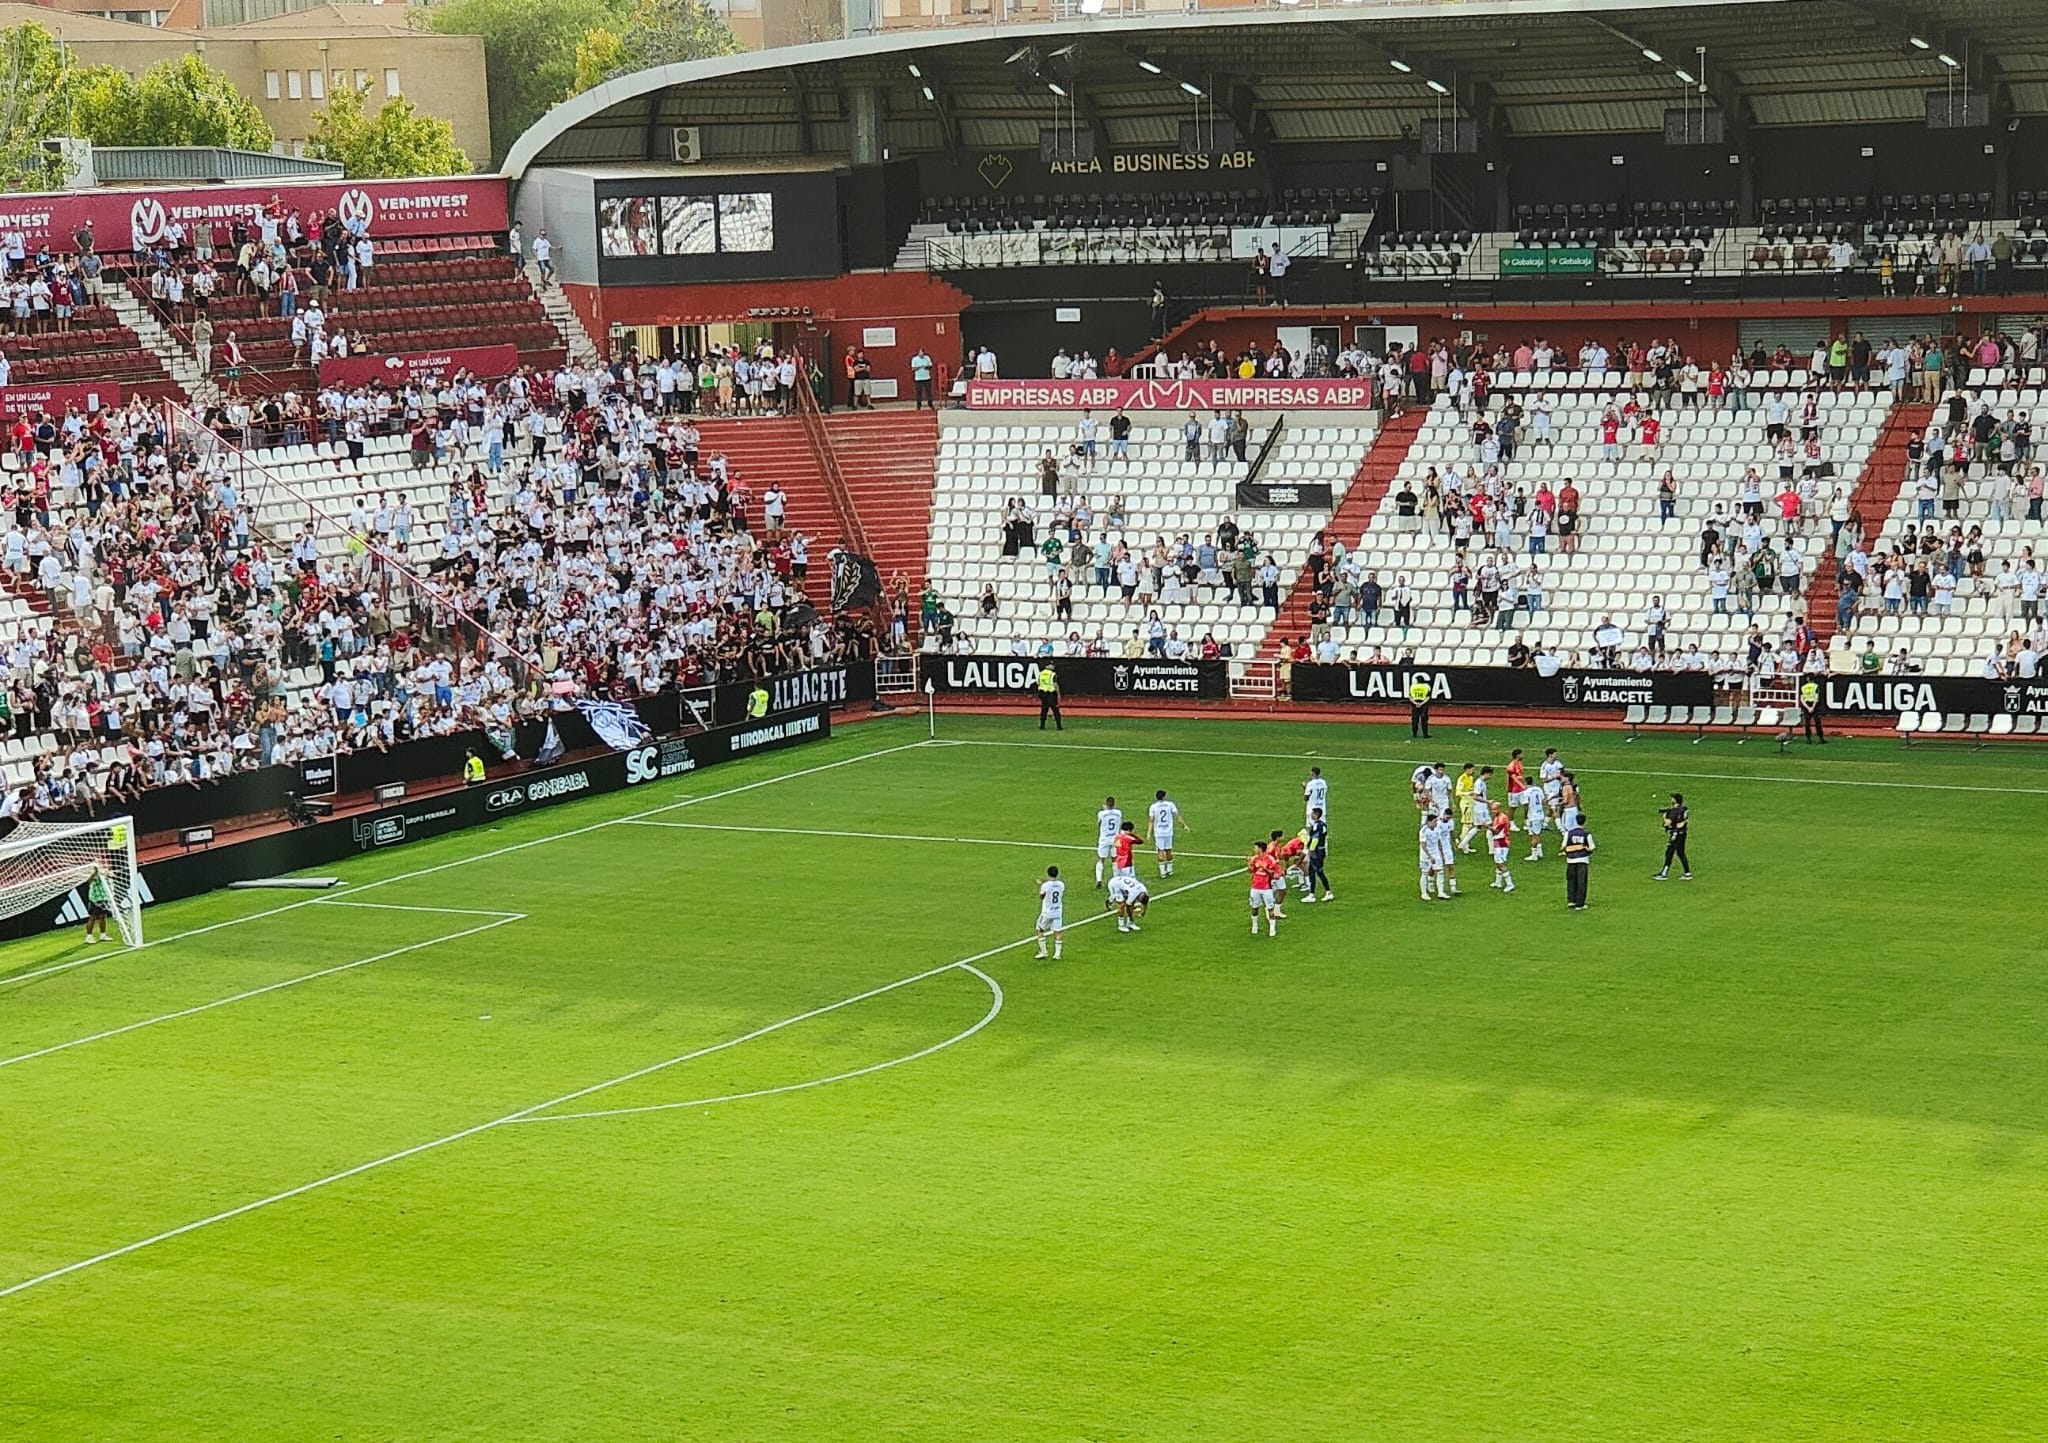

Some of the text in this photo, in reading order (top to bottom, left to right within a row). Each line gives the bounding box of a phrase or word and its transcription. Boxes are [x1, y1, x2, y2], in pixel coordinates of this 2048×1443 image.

[1113, 153, 1210, 173] BUSINESS
[380, 208, 468, 221] HOLDING SAL
[429, 356, 452, 366] LUGAR
[5, 392, 51, 402] EN UN LUGAR
[971, 387, 1119, 406] EMPRESAS ABP
[1212, 387, 1365, 405] EMPRESAS ABP
[5, 403, 44, 413] DE TU VIDA
[947, 661, 1040, 688] LALIGA
[1133, 665, 1198, 677] Ayuntamiento
[772, 669, 847, 710] ALBACETE
[1133, 678, 1199, 691] ALBACETE
[1583, 676, 1653, 689] Ayuntamiento
[1583, 691, 1653, 704] ALBACETE
[1826, 682, 1937, 711] LALIGA
[626, 746, 658, 784] SC
[661, 759, 695, 776] RENTING
[489, 789, 522, 806] CRA
[1316, 787, 1325, 800] 10
[1159, 809, 1167, 823] 2
[1108, 818, 1116, 831] 5
[1052, 890, 1060, 904] 8
